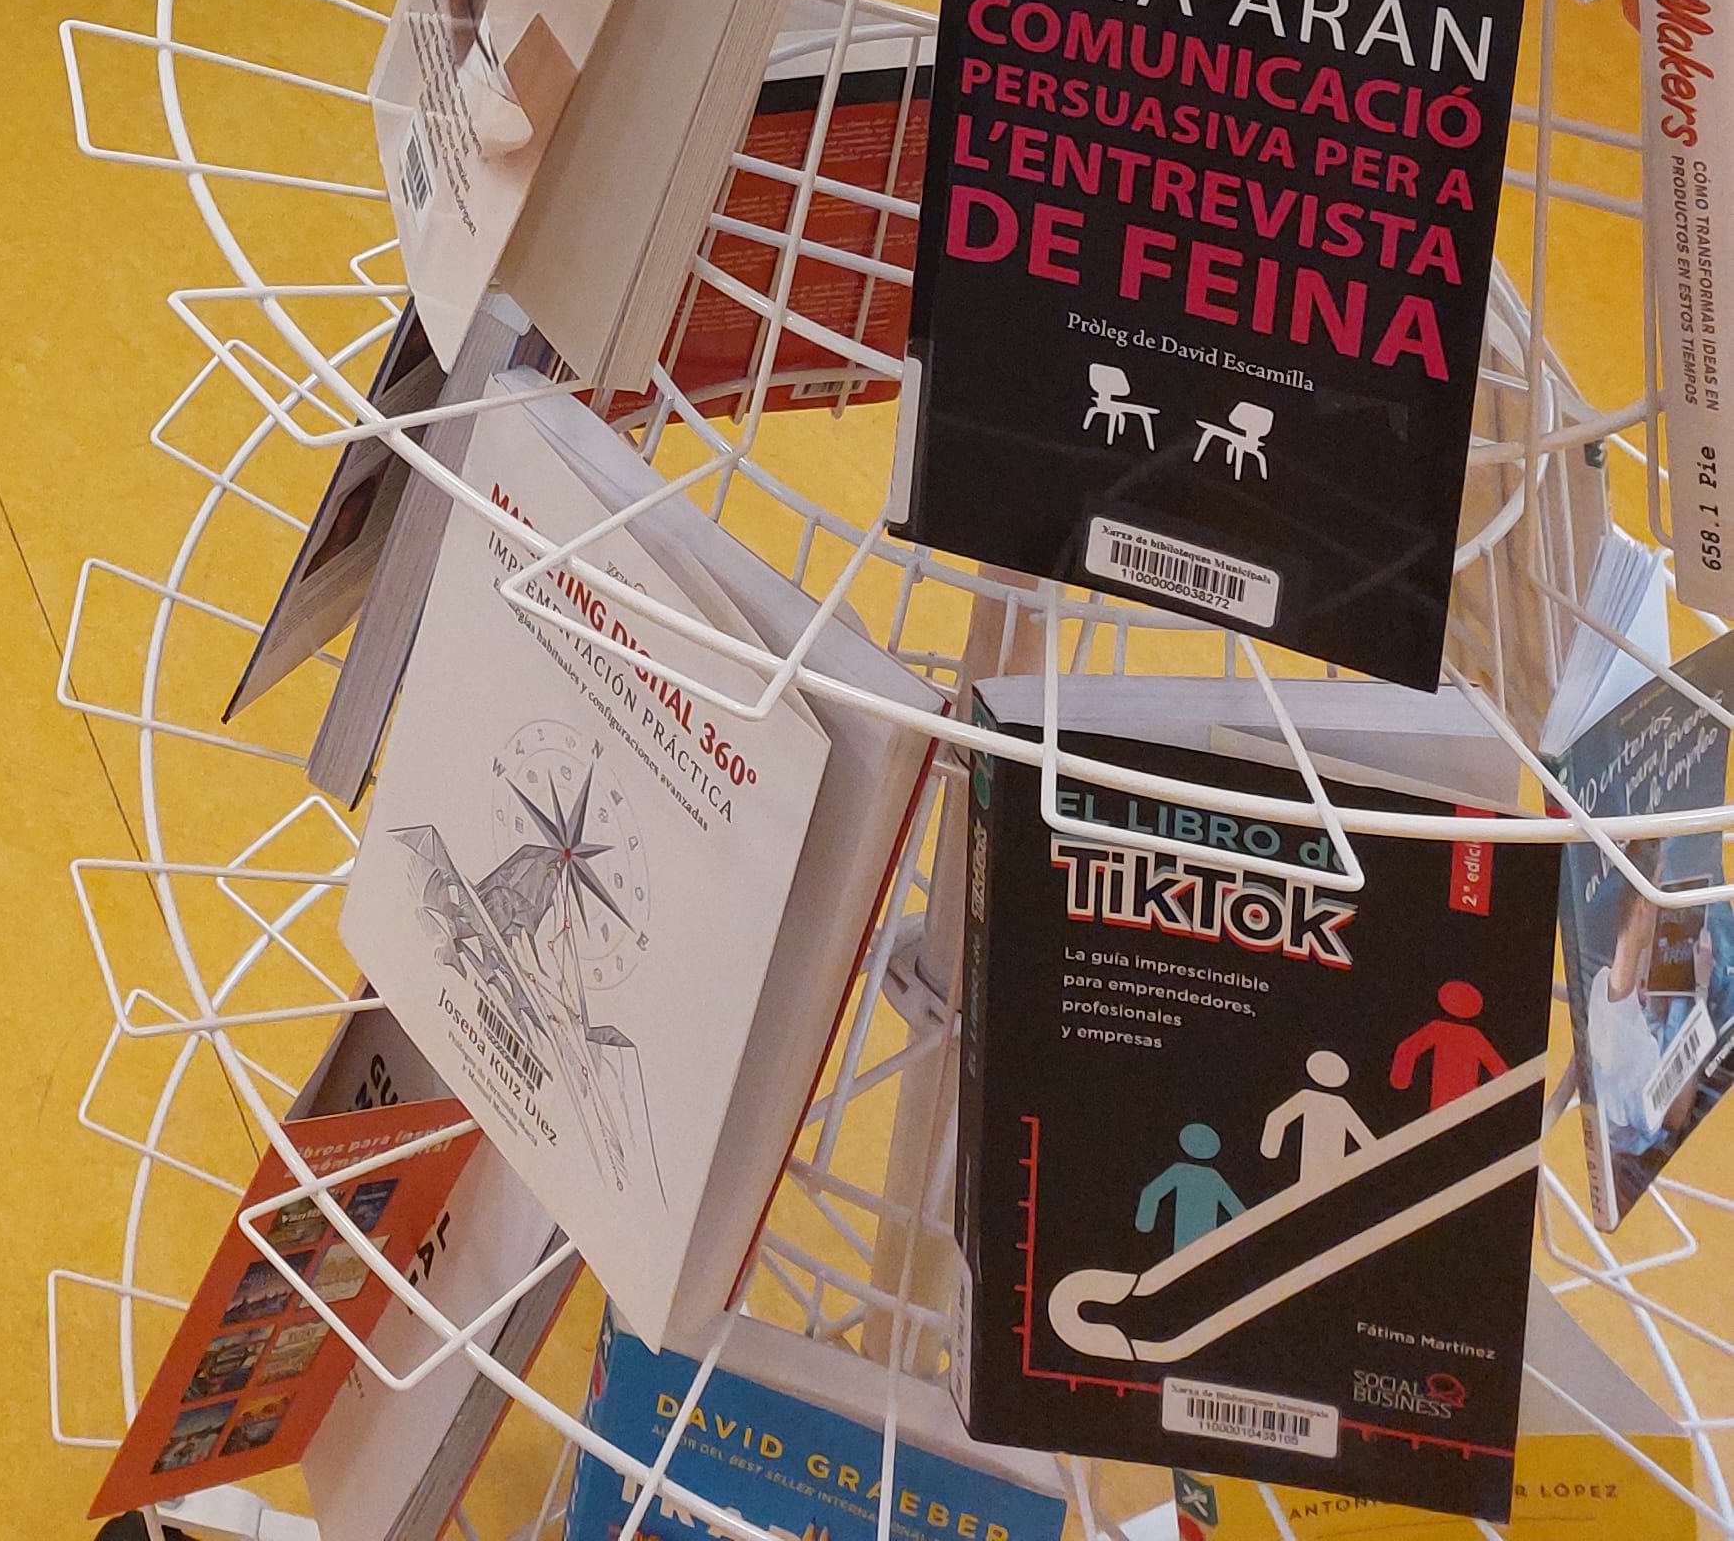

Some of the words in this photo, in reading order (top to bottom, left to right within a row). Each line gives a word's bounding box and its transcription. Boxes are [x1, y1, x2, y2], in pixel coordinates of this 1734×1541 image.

[961, 58, 1296, 169] PERSUASIVA
[1315, 136, 1421, 199] PER
[1436, 168, 1475, 211] A
[1671, 155, 1691, 255] PRODUCTOS
[1693, 160, 1710, 211] CÓMO
[945, 184, 1086, 287] DE
[1118, 223, 1451, 383] FEINA
[1677, 258, 1691, 280] EN
[1696, 215, 1716, 334] TRANSFORMAR
[1678, 282, 1694, 336] ESTOS
[1066, 311, 1129, 349] Pròleg
[1132, 328, 1157, 351] de
[1160, 336, 1219, 368] David
[1702, 335, 1719, 384] IDEAS
[1681, 337, 1698, 406] TIEMPOS
[1707, 389, 1720, 411] EN
[1697, 445, 1717, 490] Pie
[642, 706, 735, 824] PRÁCTICA
[1064, 946, 1086, 963] La
[1091, 951, 1130, 969] guía
[1134, 954, 1270, 993] imprescindible
[1061, 998, 1183, 1027] profesionales
[1063, 972, 1103, 991] para
[1107, 977, 1257, 1018] emprendedores,
[437, 987, 486, 1057] Joseba
[1060, 1025, 1072, 1039] y
[1076, 1025, 1164, 1050] empresas
[1356, 1321, 1416, 1345] Fátima
[1420, 1333, 1497, 1360] Martínez
[1353, 1369, 1425, 1397] SOCIAL
[1353, 1386, 1452, 1419] BUSINESS
